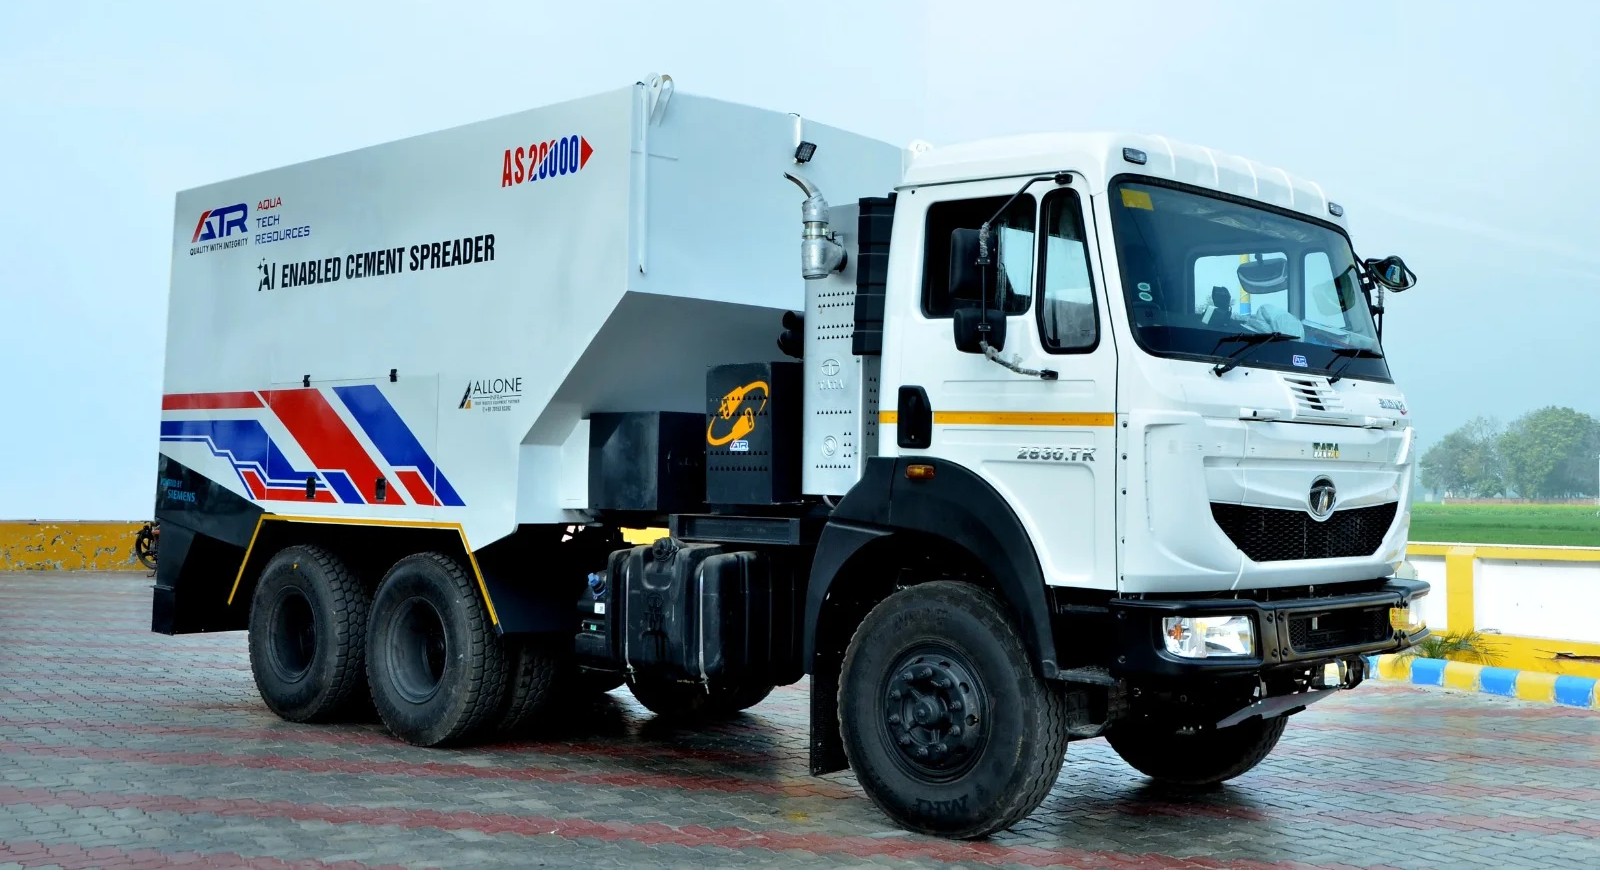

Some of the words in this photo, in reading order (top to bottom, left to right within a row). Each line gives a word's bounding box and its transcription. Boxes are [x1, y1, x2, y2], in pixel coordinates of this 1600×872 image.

[501, 146, 525, 188] AS
[528, 134, 579, 182] 20000
[256, 196, 282, 211] AQUA
[191, 202, 248, 243] ATR
[256, 214, 280, 229] TECH
[254, 225, 311, 245] RESOURCES
[189, 244, 210, 256] QUALITY
[209, 242, 223, 252] WITH
[223, 237, 249, 250] INTEGRITY
[281, 256, 342, 289] ENABLED
[345, 246, 406, 280] CEMENT
[409, 233, 496, 272] SPREADER
[473, 377, 522, 394] ALLONE
[730, 440, 748, 450] ATR
[1312, 442, 1339, 459] TATA
[1016, 446, 1096, 462] 2830.TK
[168, 490, 196, 502] SIEMENS
